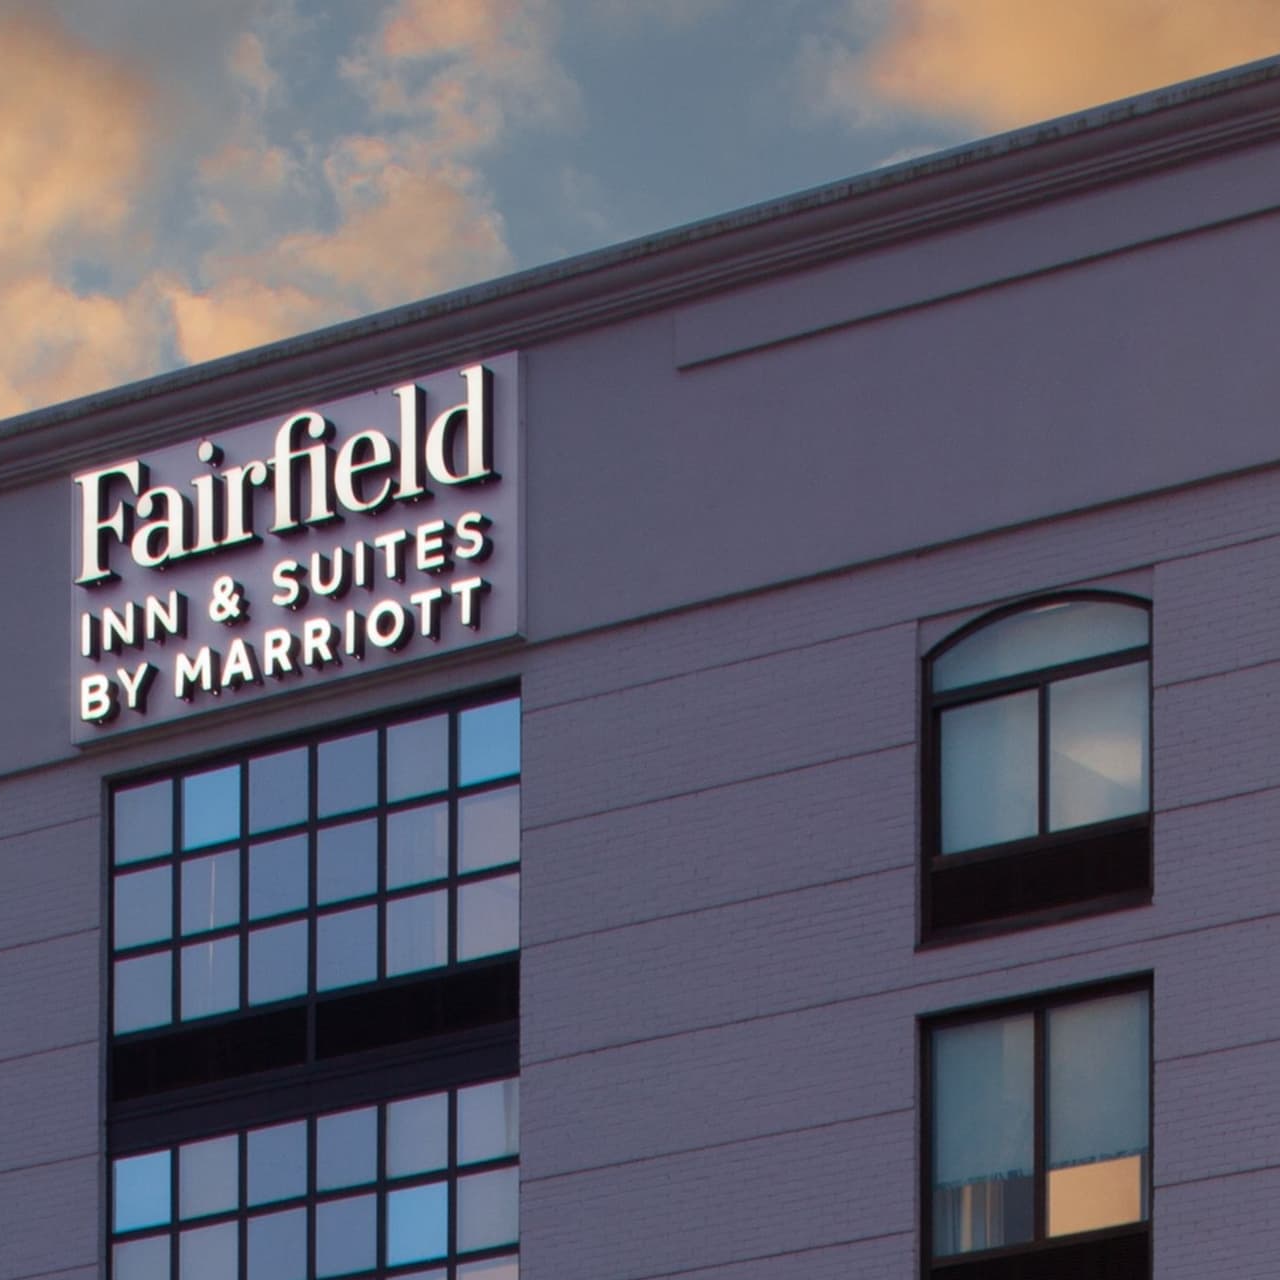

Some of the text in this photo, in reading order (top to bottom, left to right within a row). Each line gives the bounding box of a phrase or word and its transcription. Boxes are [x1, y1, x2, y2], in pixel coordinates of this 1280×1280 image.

[74, 364, 492, 584] Fairfield
[80, 511, 484, 658] INN & SUITES
[80, 576, 483, 721] BY MARRIOTT
